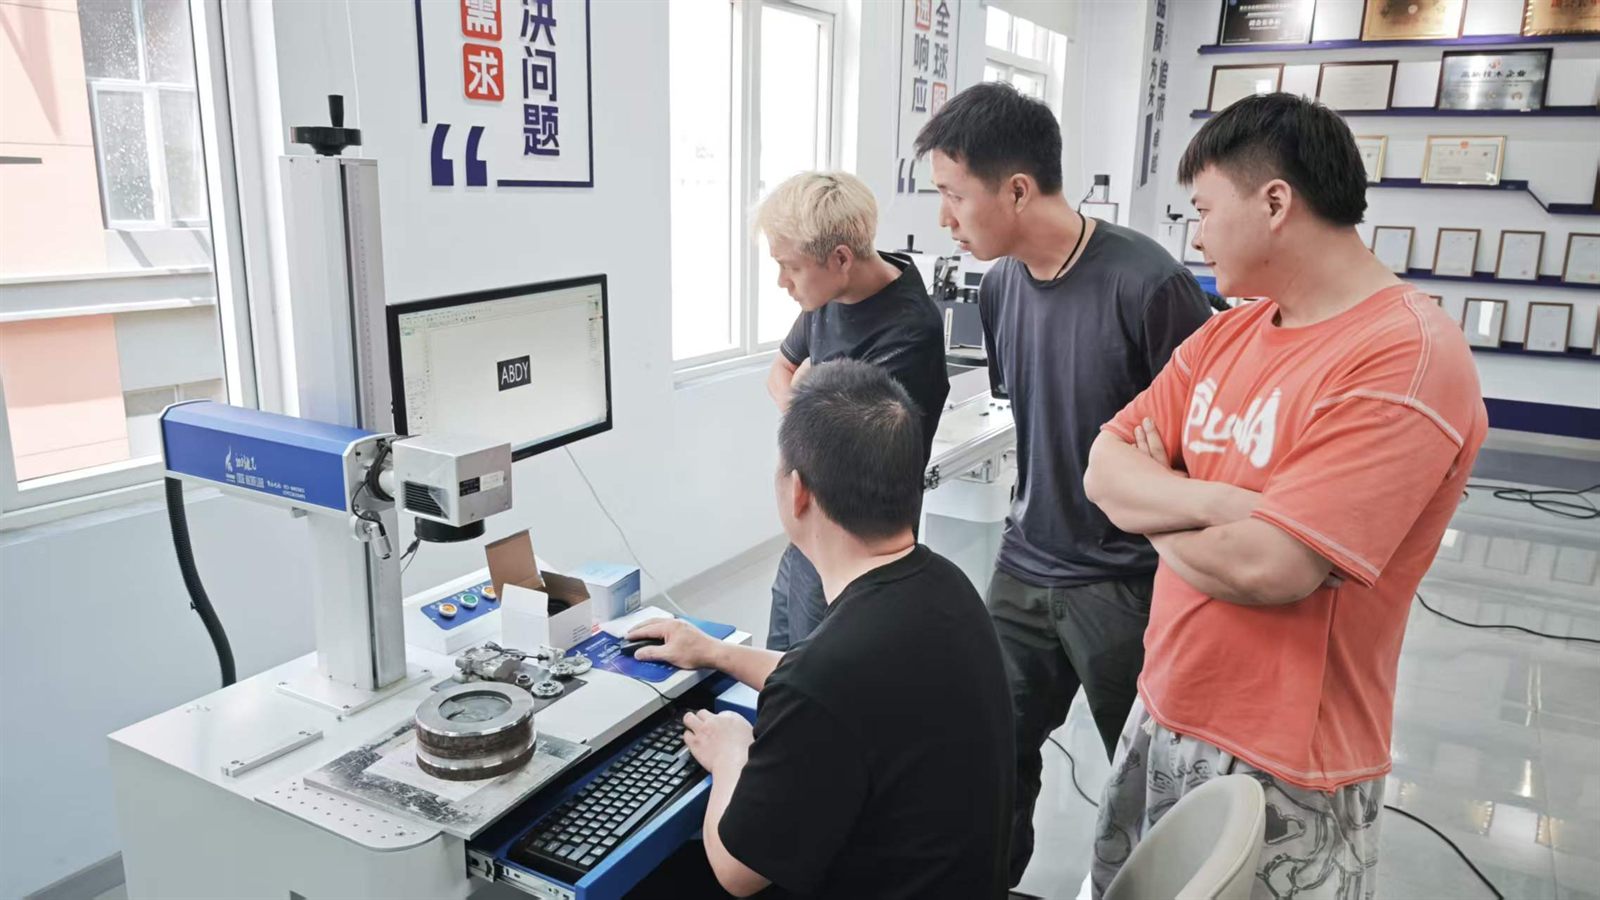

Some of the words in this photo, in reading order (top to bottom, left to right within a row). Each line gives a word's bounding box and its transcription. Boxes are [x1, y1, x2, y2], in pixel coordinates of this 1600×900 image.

[520, 0, 560, 156] 决问题
[500, 361, 529, 385] ABDY
